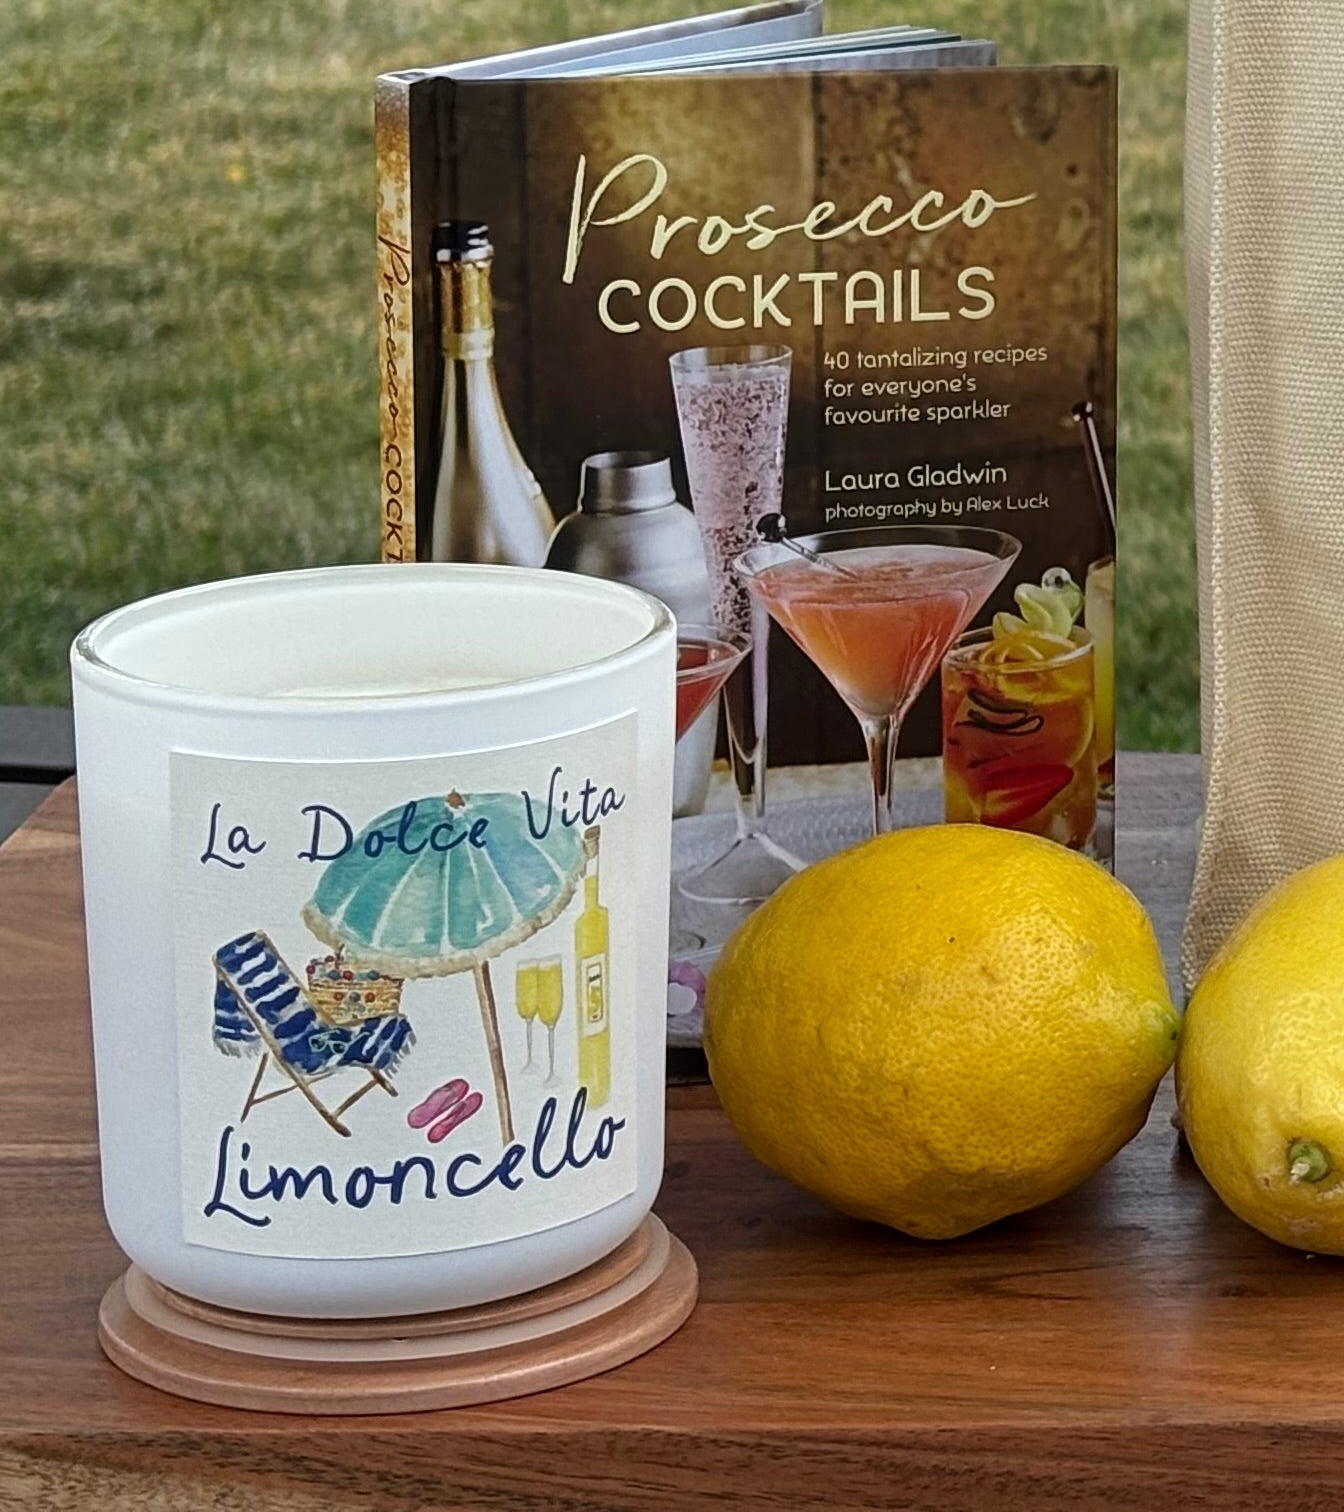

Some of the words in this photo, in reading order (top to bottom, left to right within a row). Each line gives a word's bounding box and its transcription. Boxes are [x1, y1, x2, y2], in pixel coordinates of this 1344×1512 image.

[563, 153, 1038, 285] Prosecco
[598, 266, 997, 335] COCKTAILS
[378, 234, 411, 439] Prosecco
[823, 350, 850, 370] 40
[857, 346, 968, 369] tantalizing
[973, 343, 1048, 367] recipes
[824, 377, 854, 399] for
[861, 373, 977, 399] everyone's
[824, 403, 922, 426] favourite
[926, 399, 1012, 425] sparkler
[825, 469, 900, 492] Laura
[907, 460, 1008, 488] Gladwin
[825, 499, 937, 523] photography
[940, 498, 963, 516] by
[966, 496, 1002, 513] Alex
[1006, 493, 1050, 511] Luck
[200, 802, 268, 872] La
[299, 800, 490, 865] Dolce
[520, 765, 627, 841] Vita
[202, 1085, 628, 1228] Limoncello
